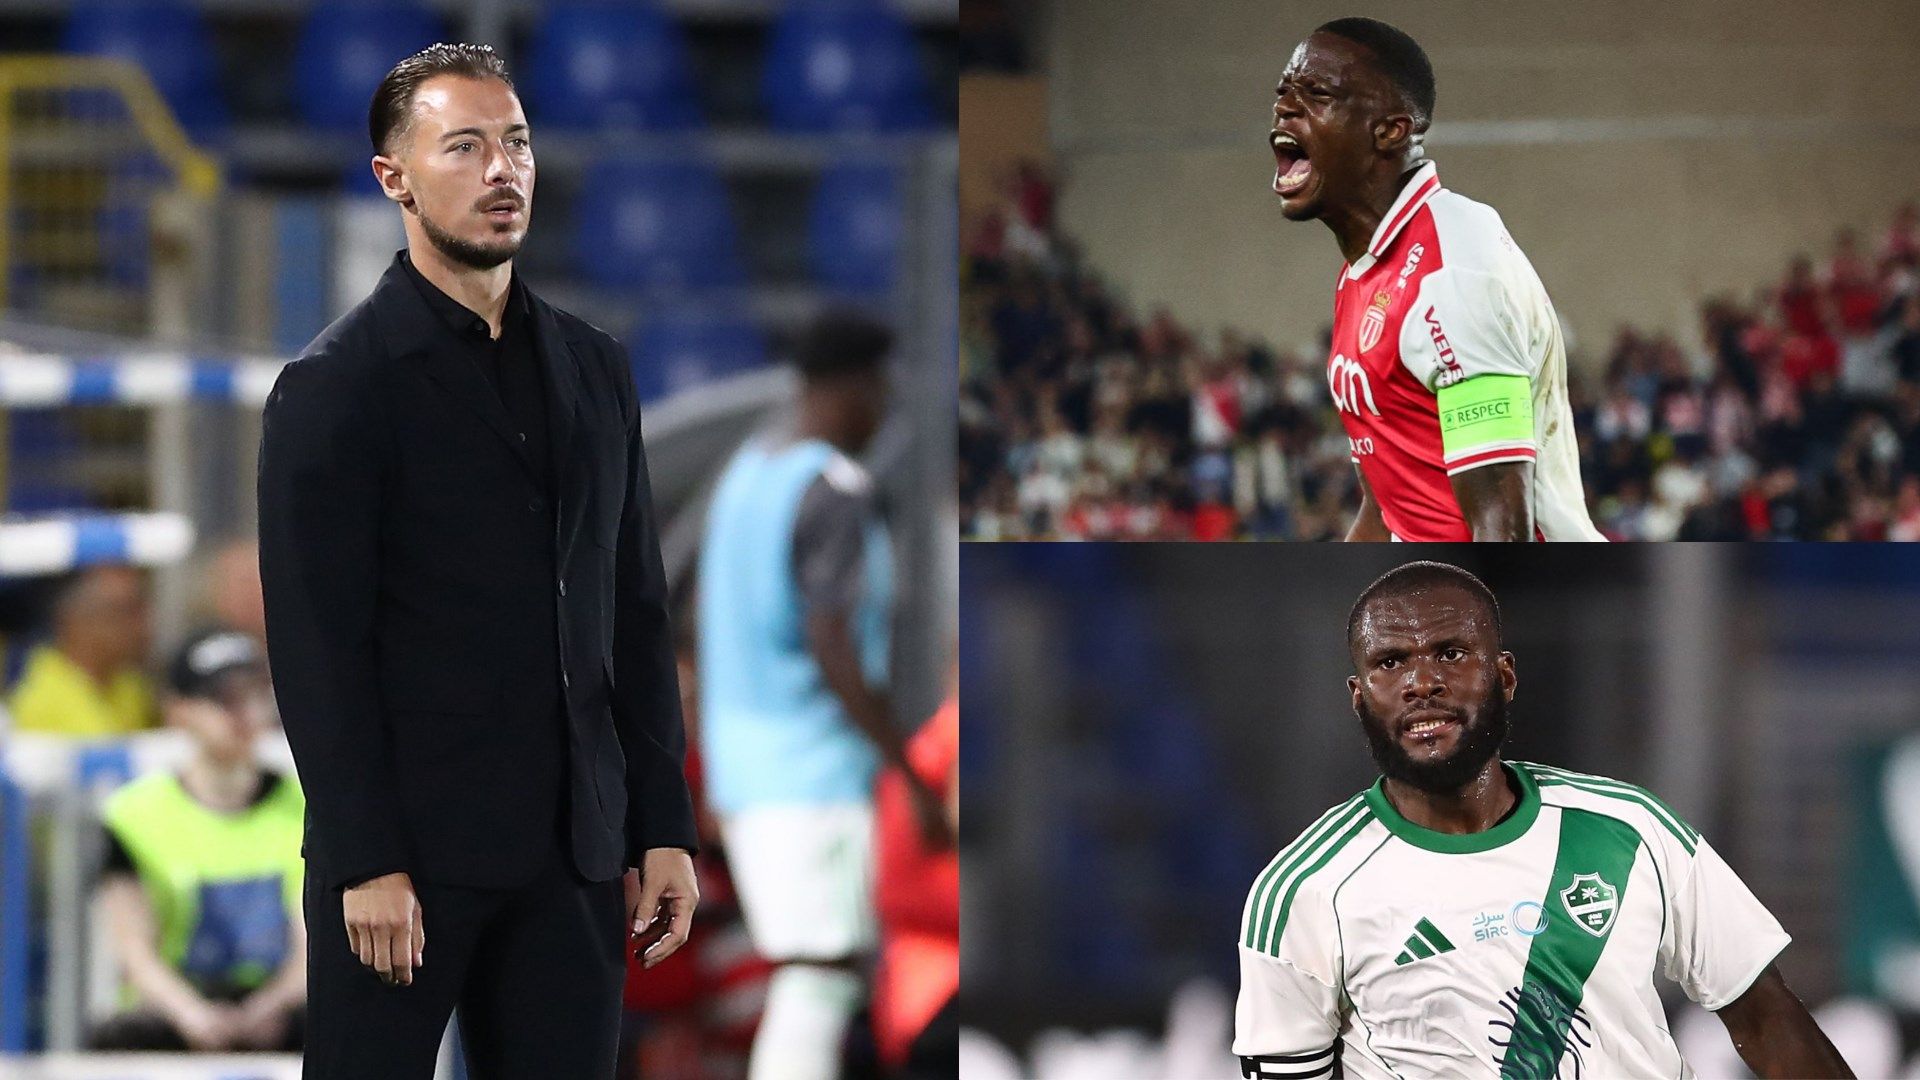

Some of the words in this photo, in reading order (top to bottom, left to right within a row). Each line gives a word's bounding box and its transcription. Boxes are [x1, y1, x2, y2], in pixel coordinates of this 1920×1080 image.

[1425, 305, 1466, 383] VREDE
[1457, 402, 1510, 423] RESPECT
[1472, 912, 1504, 927] سرك
[1474, 925, 1508, 942] SIRC
